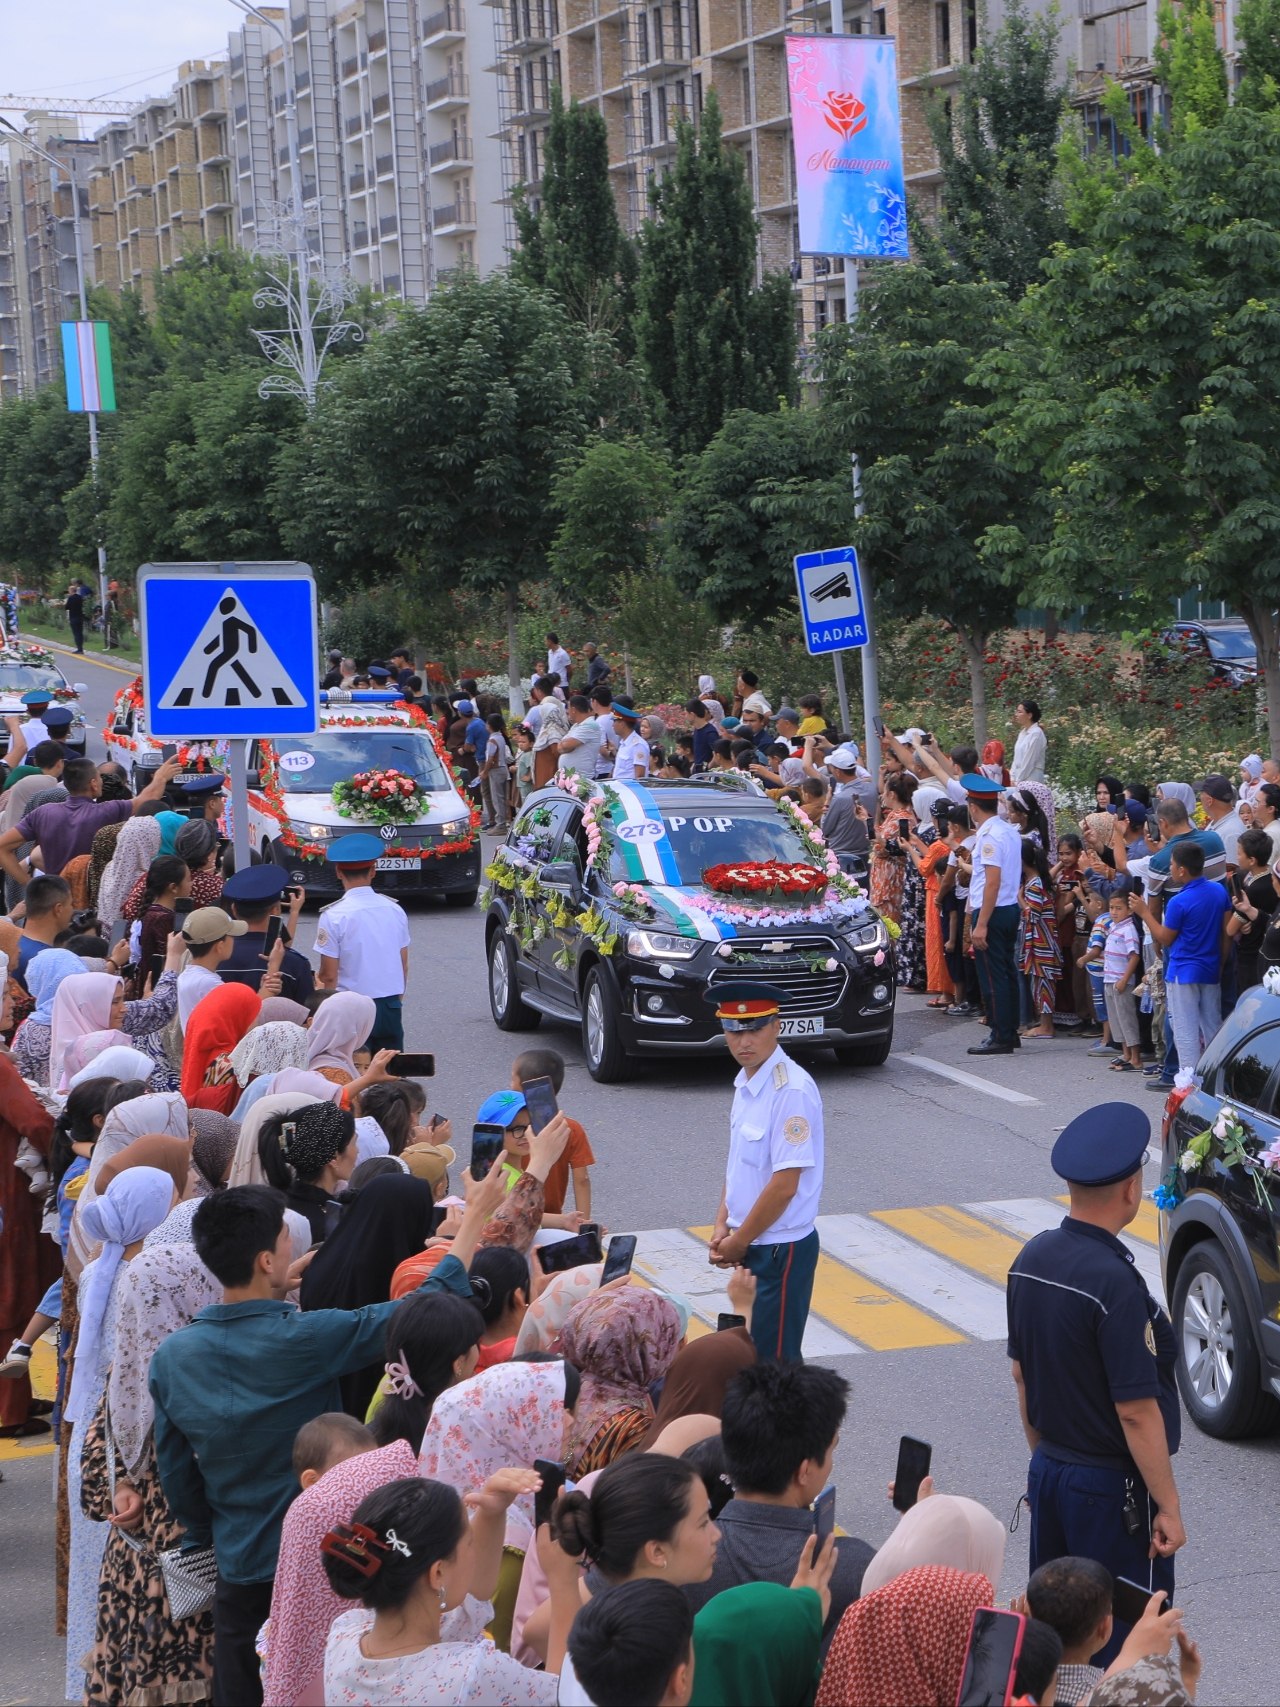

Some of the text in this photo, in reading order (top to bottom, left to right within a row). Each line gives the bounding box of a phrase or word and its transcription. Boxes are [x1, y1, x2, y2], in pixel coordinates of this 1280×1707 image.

[807, 149, 889, 175] Namangan
[811, 624, 864, 644] RADAR
[286, 756, 309, 766] 113
[620, 823, 662, 839] 273
[669, 816, 735, 833] POP
[394, 859, 415, 869] STY
[797, 1020, 815, 1034] SA
